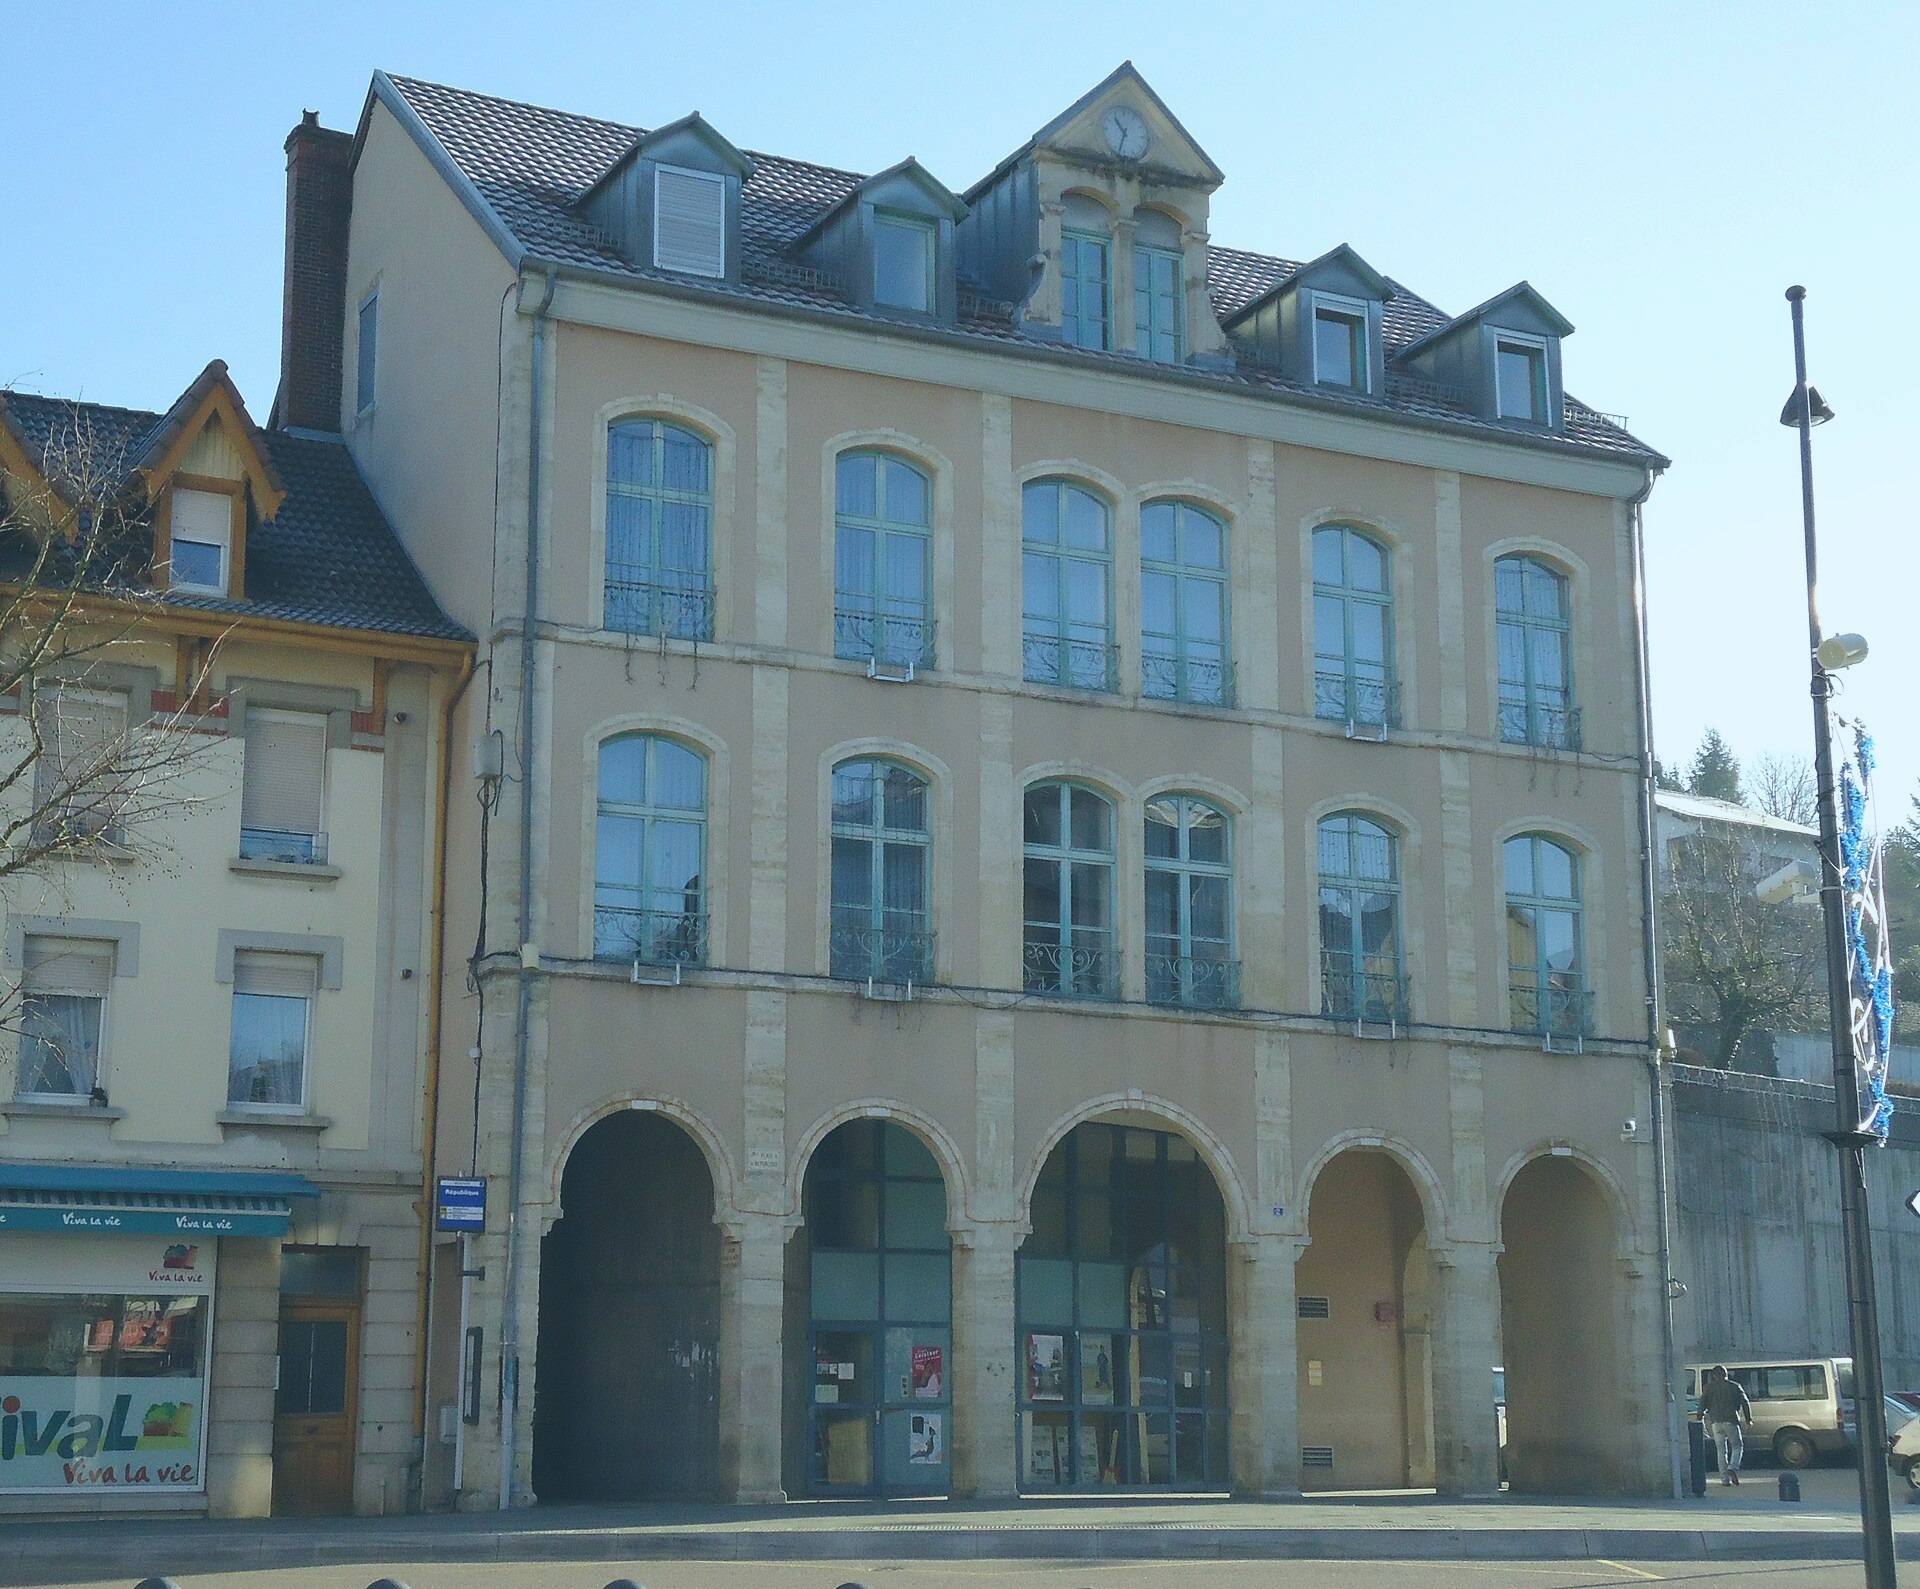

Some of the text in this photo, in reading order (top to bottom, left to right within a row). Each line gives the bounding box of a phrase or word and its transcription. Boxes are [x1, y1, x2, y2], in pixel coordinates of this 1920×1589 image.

[445, 1188, 479, 1196] République
[62, 1212, 87, 1226] Viva
[105, 1215, 121, 1226] vie
[175, 1215, 200, 1229] Viva
[216, 1218, 233, 1230] vie
[149, 1270, 171, 1283] Viva
[187, 1272, 204, 1283] vie
[62, 1456, 118, 1485] Viva
[157, 1462, 195, 1483] vie
